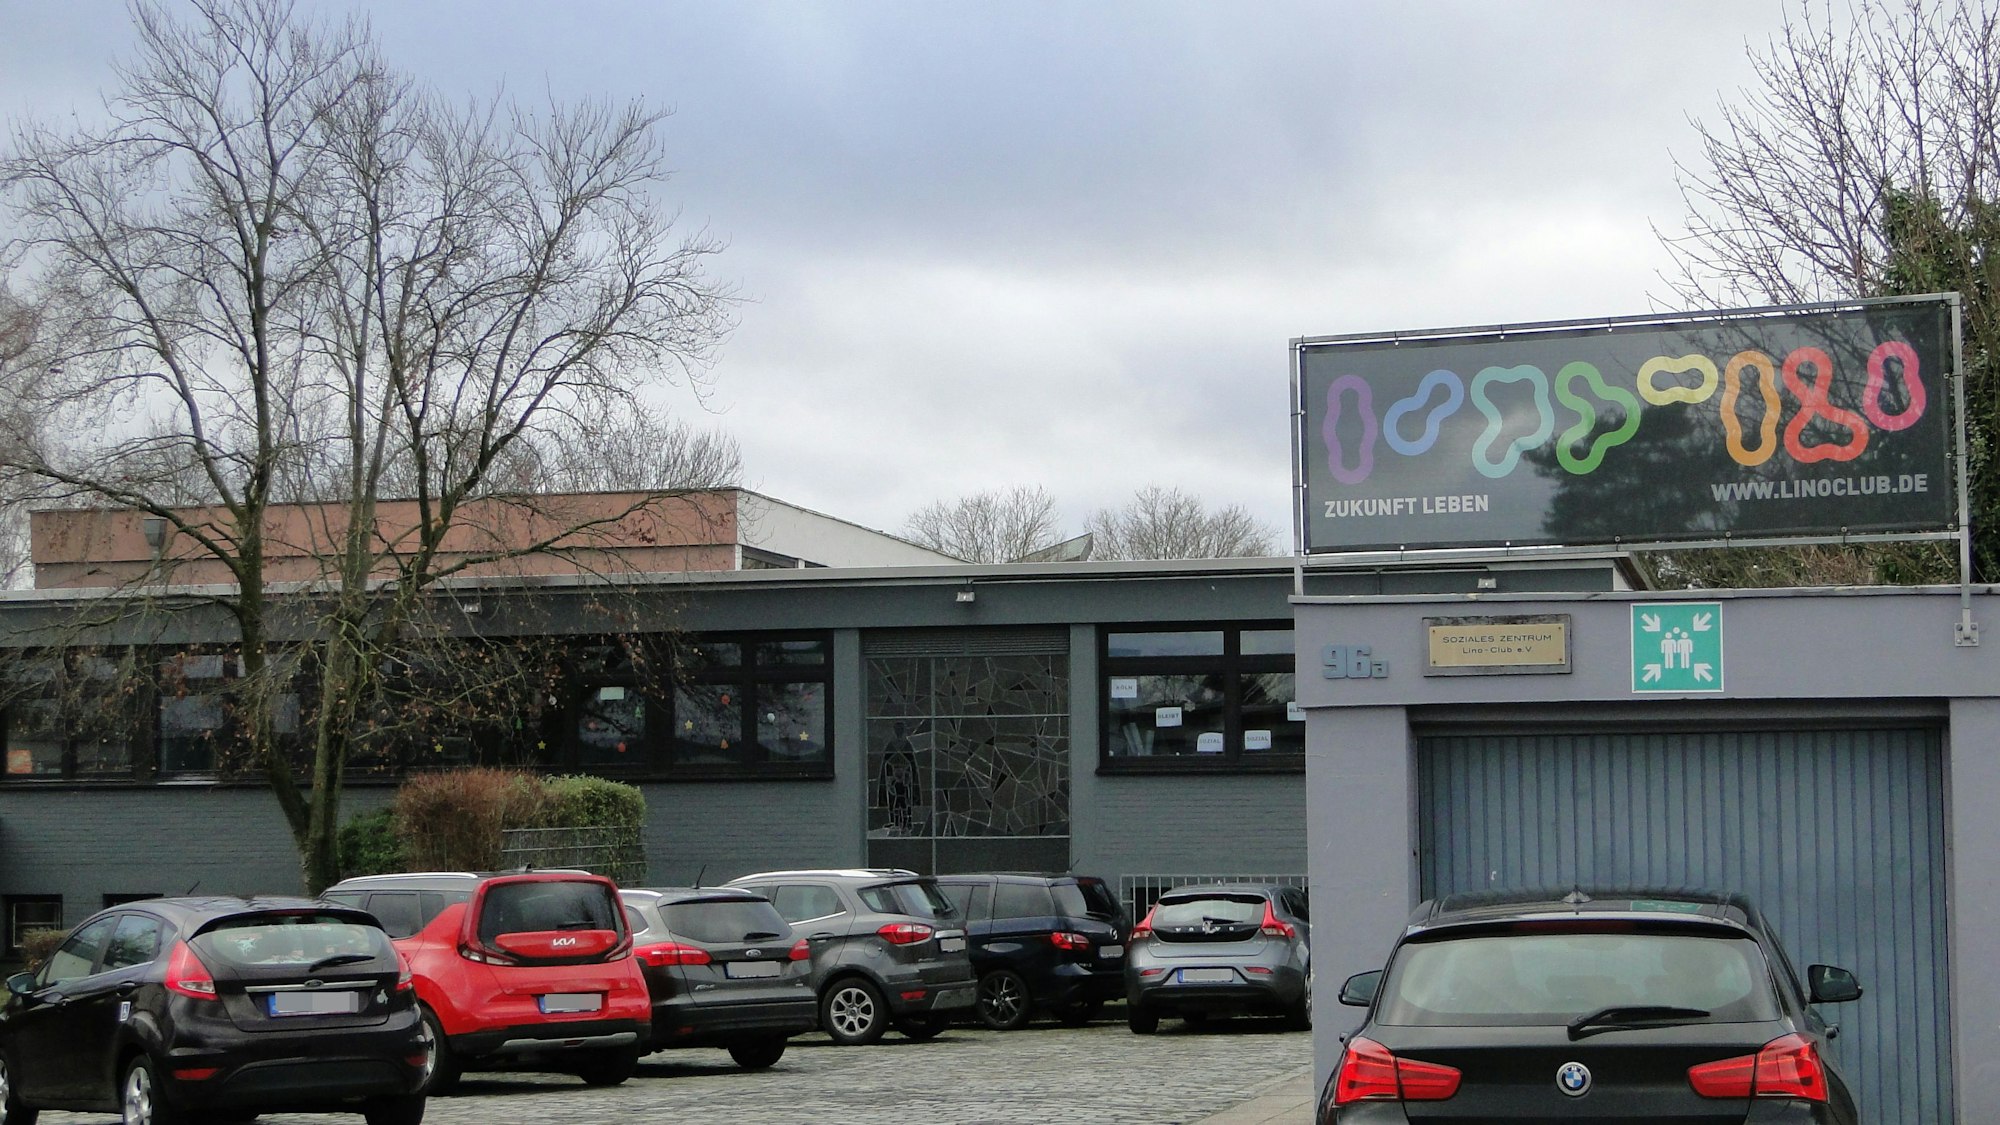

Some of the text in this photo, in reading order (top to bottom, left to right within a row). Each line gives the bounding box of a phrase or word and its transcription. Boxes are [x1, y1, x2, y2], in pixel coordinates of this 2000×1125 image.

[1711, 473, 1928, 501] WWW.LINOCLUB.DE
[1324, 494, 1489, 518] ZUKUNFT LEBEN
[1442, 634, 1552, 644] SOZIALES ZENTRUM
[1322, 645, 1389, 679] 96a
